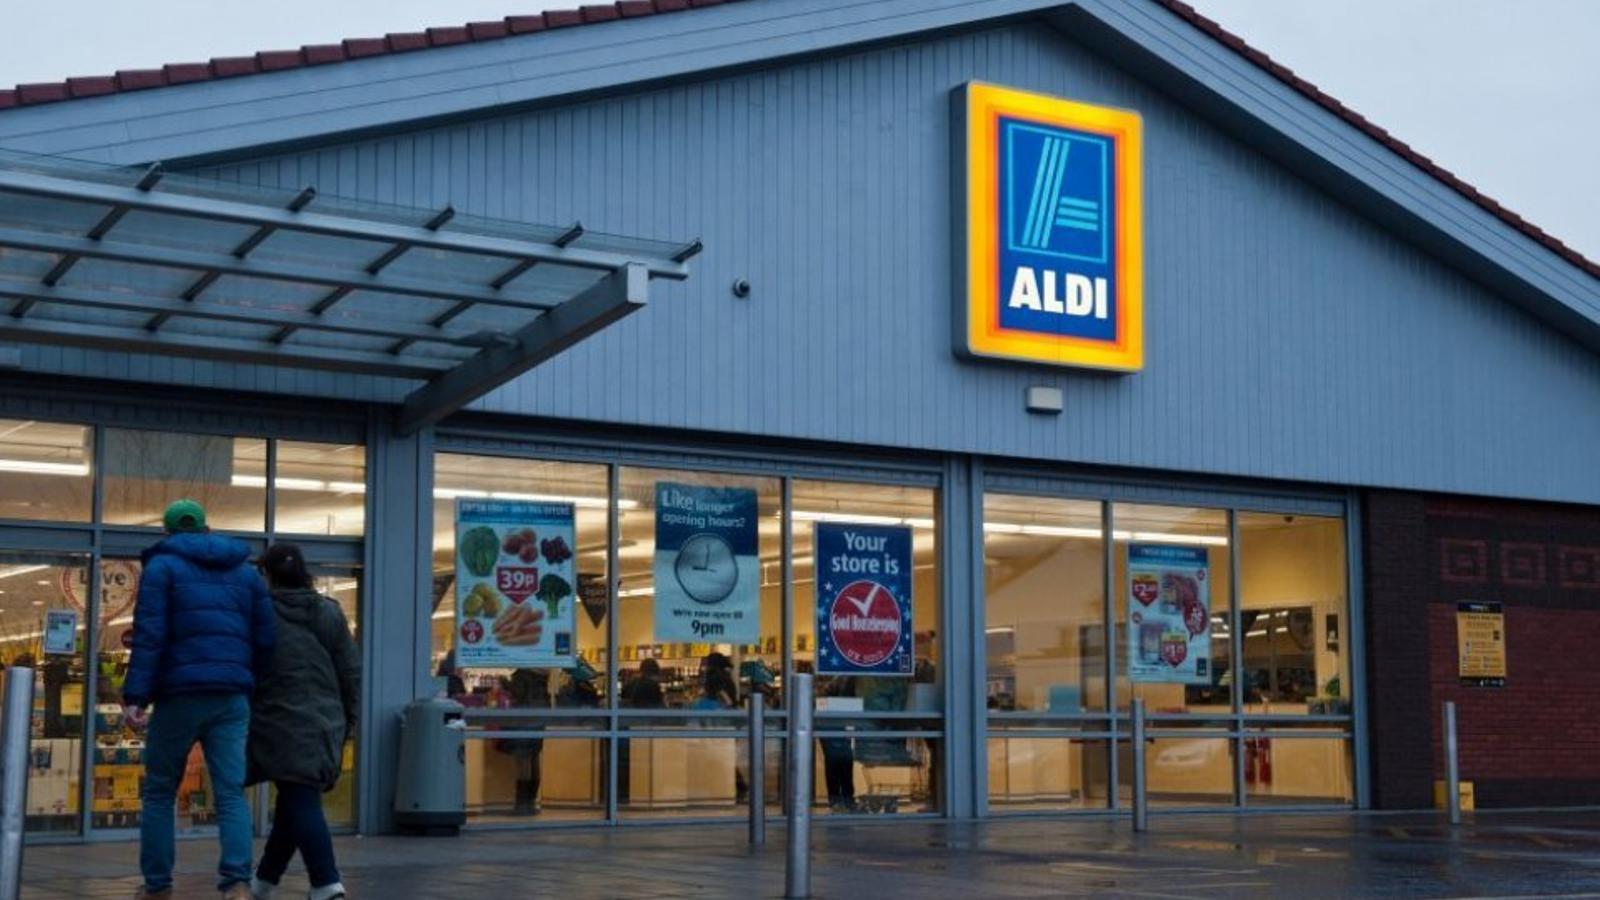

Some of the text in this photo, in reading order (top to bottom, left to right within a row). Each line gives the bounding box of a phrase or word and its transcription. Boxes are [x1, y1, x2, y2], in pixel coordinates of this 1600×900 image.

[1008, 266, 1108, 320] ALDI
[661, 488, 735, 516] Like longer
[662, 512, 746, 529] opening hours?
[843, 531, 888, 552] Your
[831, 553, 900, 576] store is
[79, 568, 127, 586] Lve
[499, 569, 535, 589] 39p
[691, 619, 725, 639] 9pm
